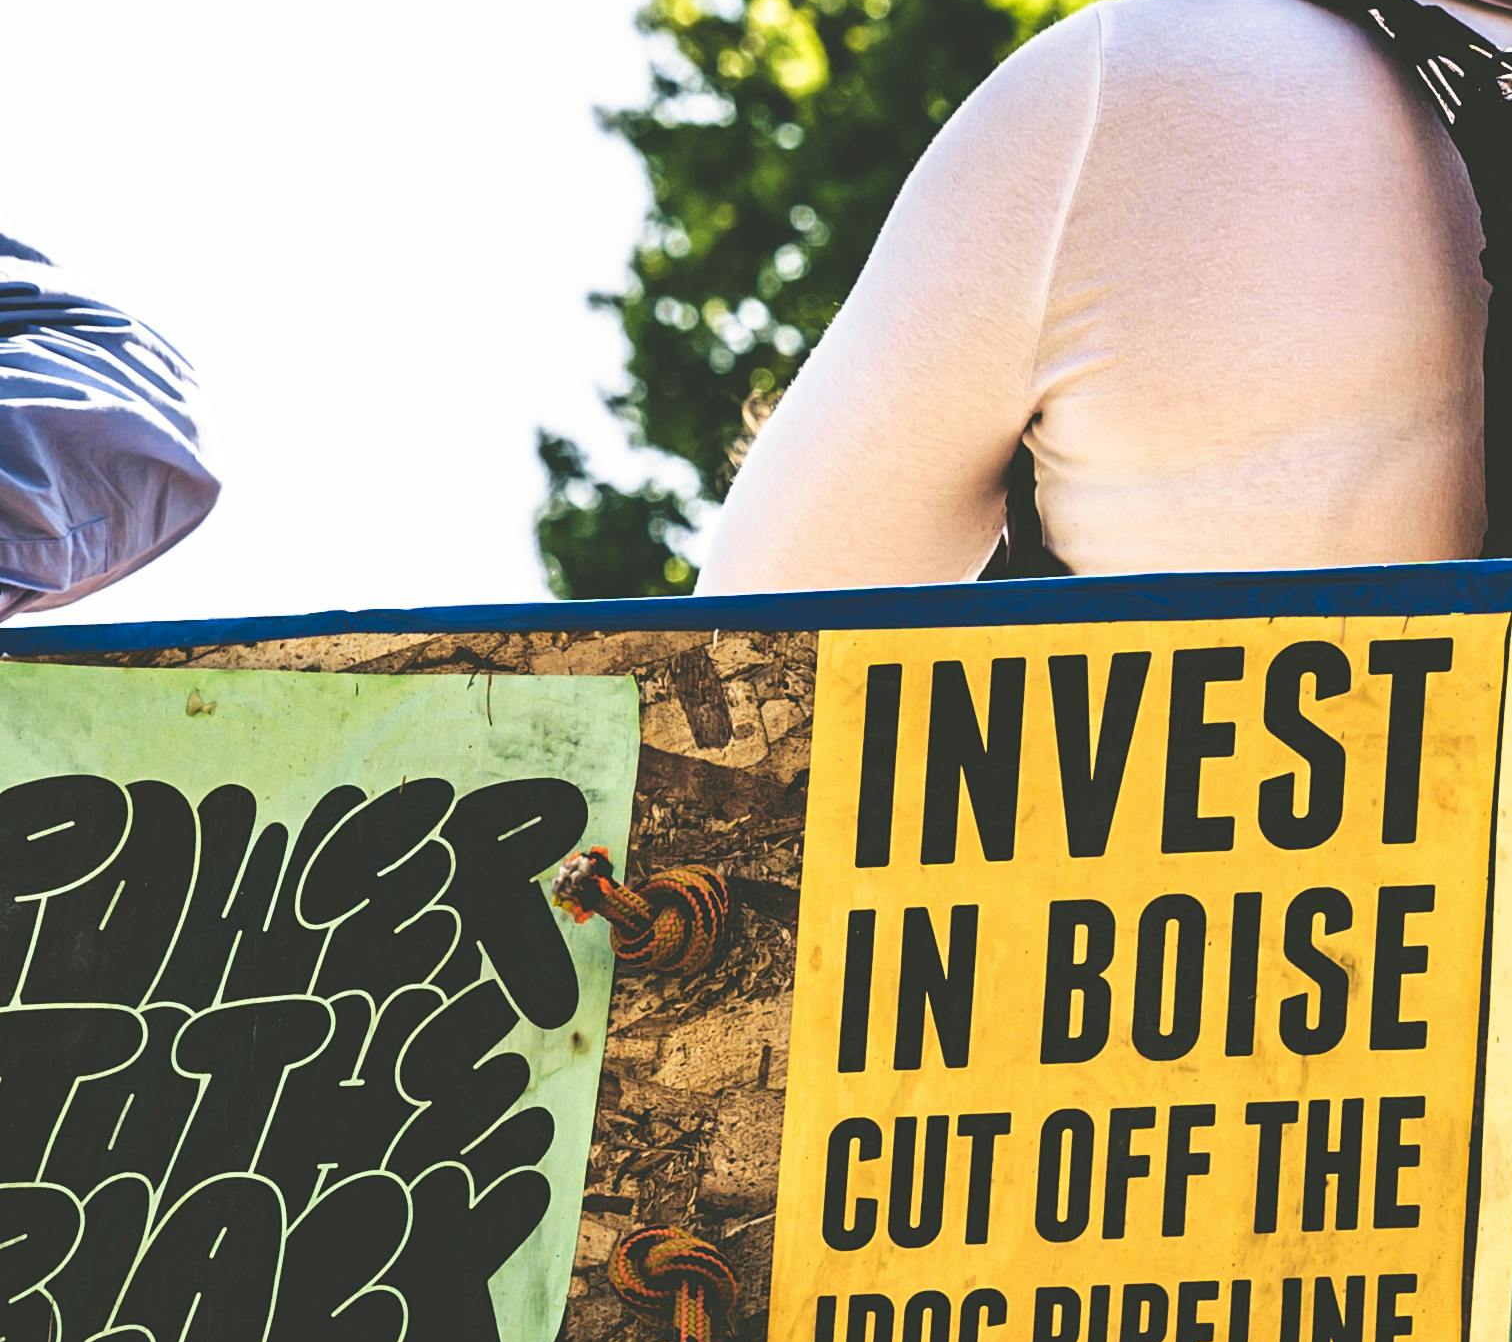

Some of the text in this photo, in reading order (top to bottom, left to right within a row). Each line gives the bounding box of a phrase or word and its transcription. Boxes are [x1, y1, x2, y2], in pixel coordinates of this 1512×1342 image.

[855, 638, 1453, 868] INVEST
[838, 885, 1435, 1073] IN BOISE
[823, 1096, 1425, 1251] CUT OFF THE
